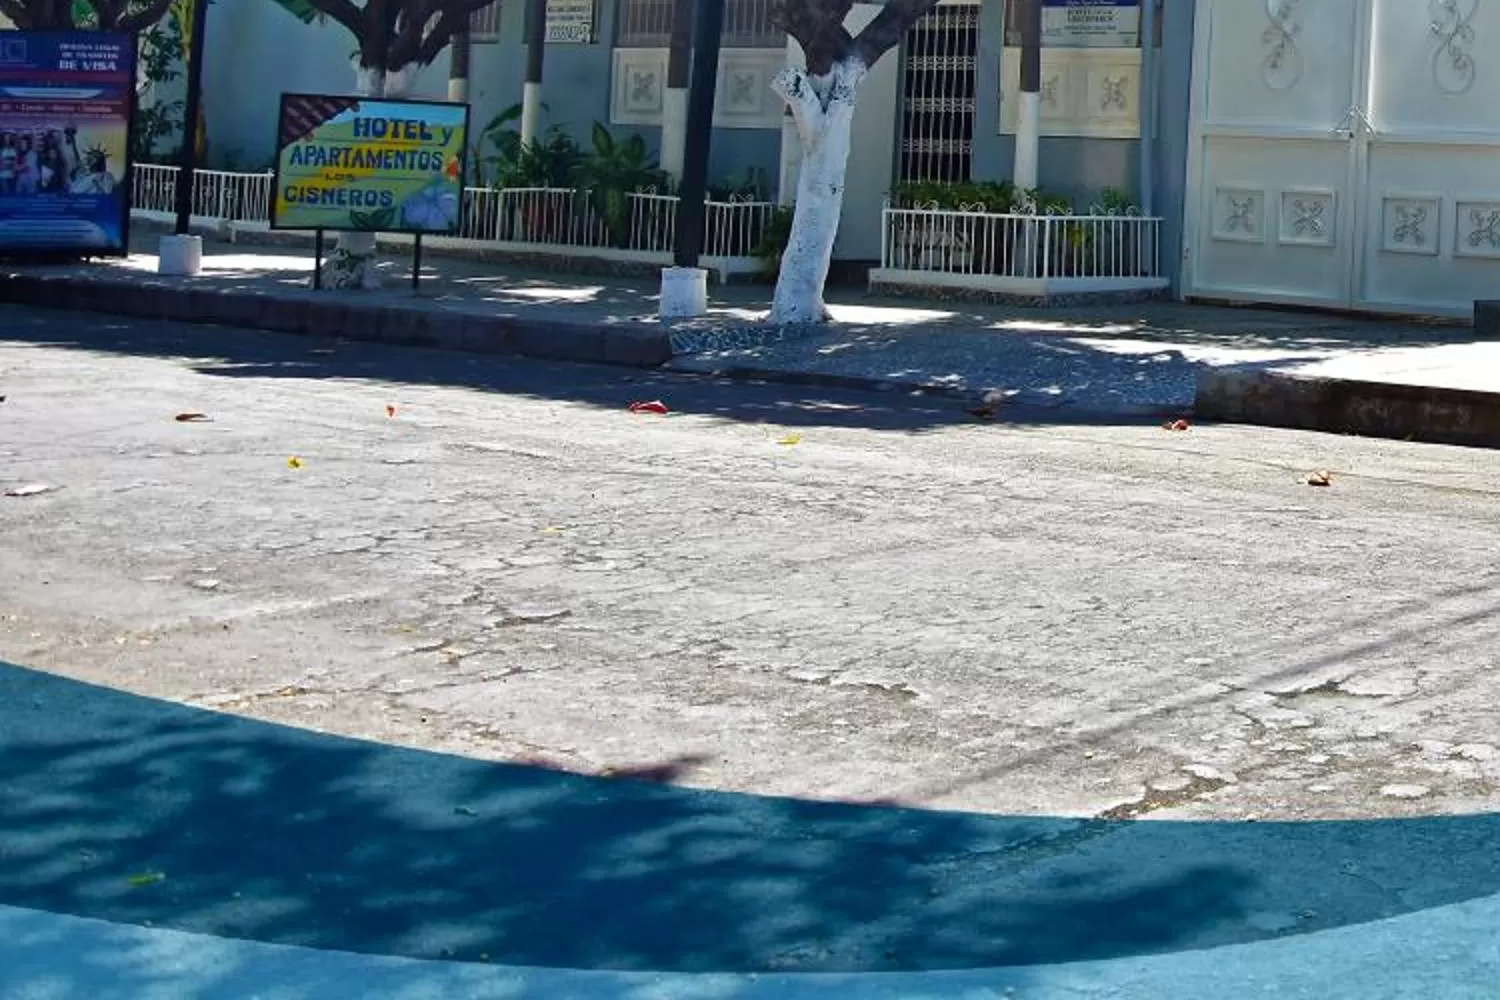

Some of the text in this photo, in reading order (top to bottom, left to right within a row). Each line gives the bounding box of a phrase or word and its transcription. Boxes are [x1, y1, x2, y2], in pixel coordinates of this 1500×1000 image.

[82, 60, 117, 71] VISA
[353, 117, 433, 141] HOTEL
[290, 145, 444, 171] APARTAMENTOS
[284, 185, 394, 207] CISNEROS
